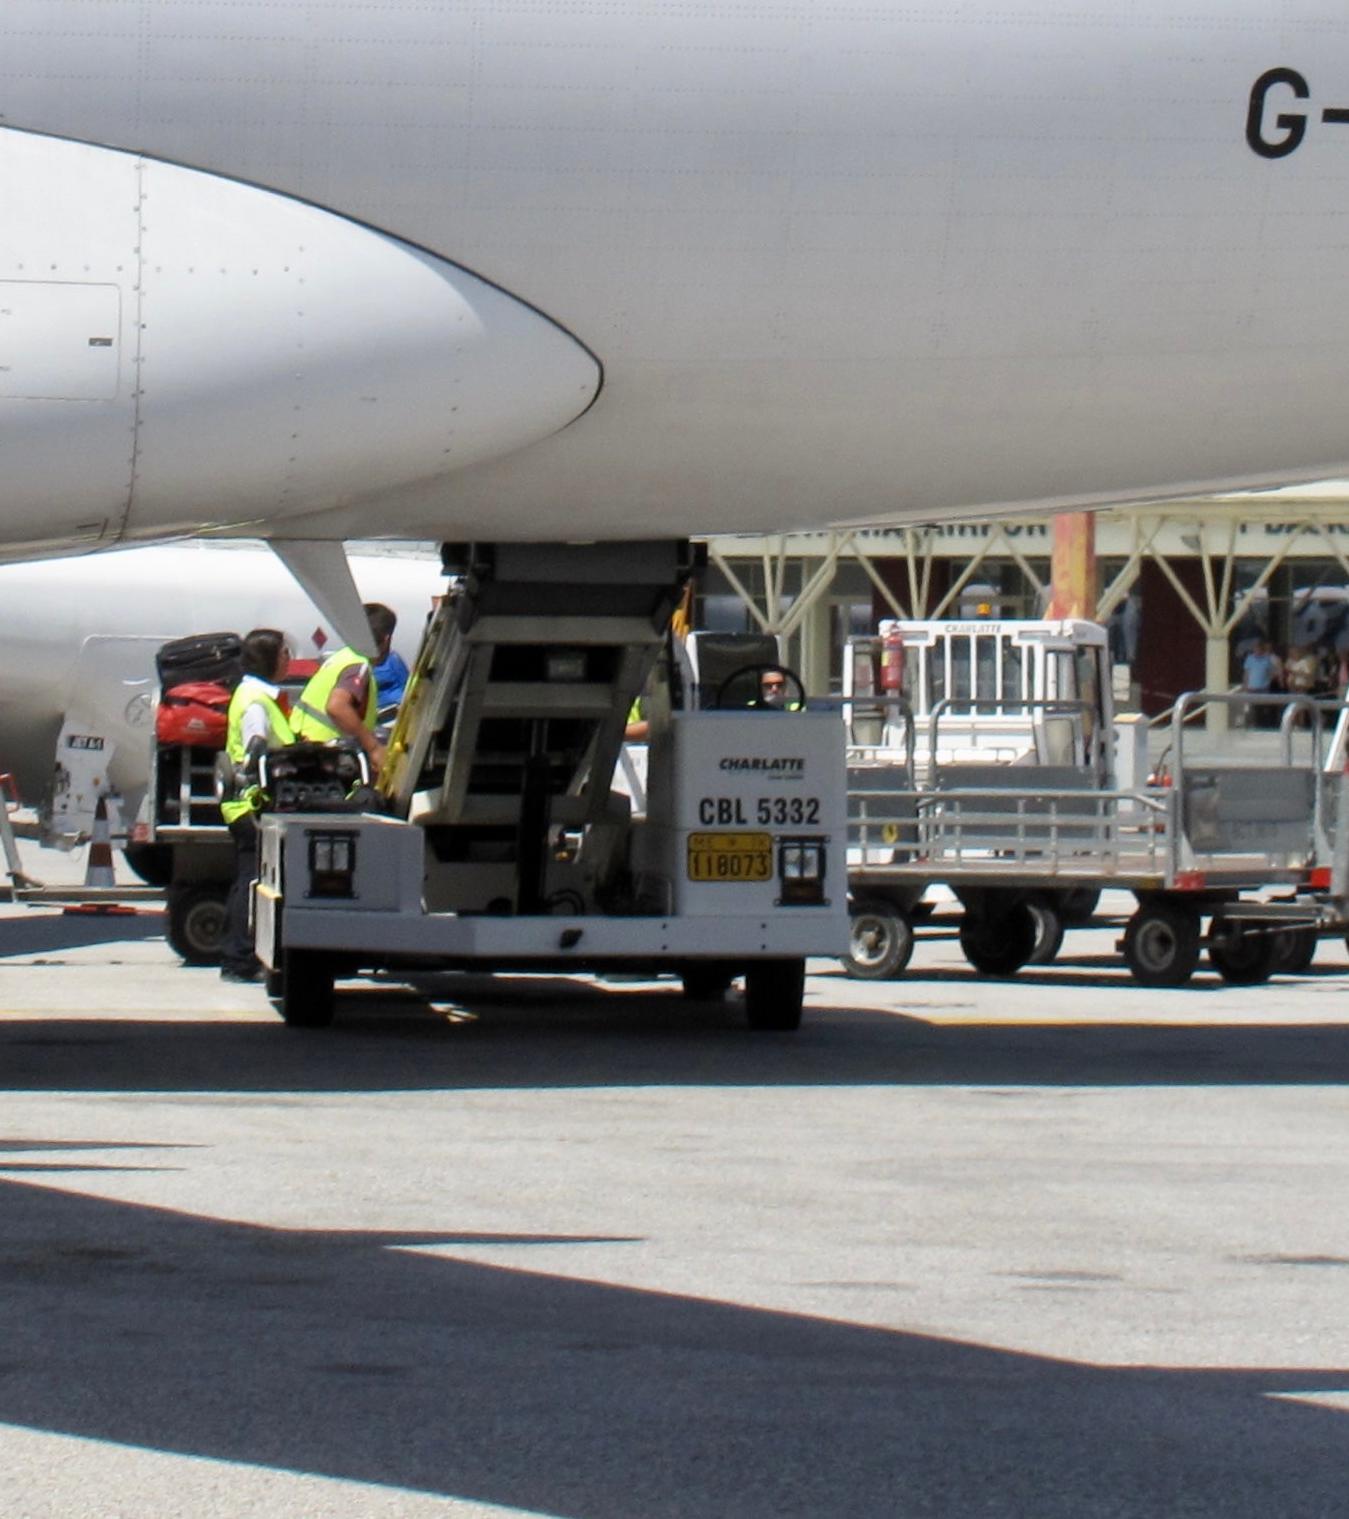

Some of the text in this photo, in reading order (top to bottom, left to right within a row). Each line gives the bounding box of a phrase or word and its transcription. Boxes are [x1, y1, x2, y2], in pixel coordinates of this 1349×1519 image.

[719, 757, 805, 771] CHARLATTE
[699, 798, 819, 825] CBL 5332
[694, 852, 768, 876] 118073
